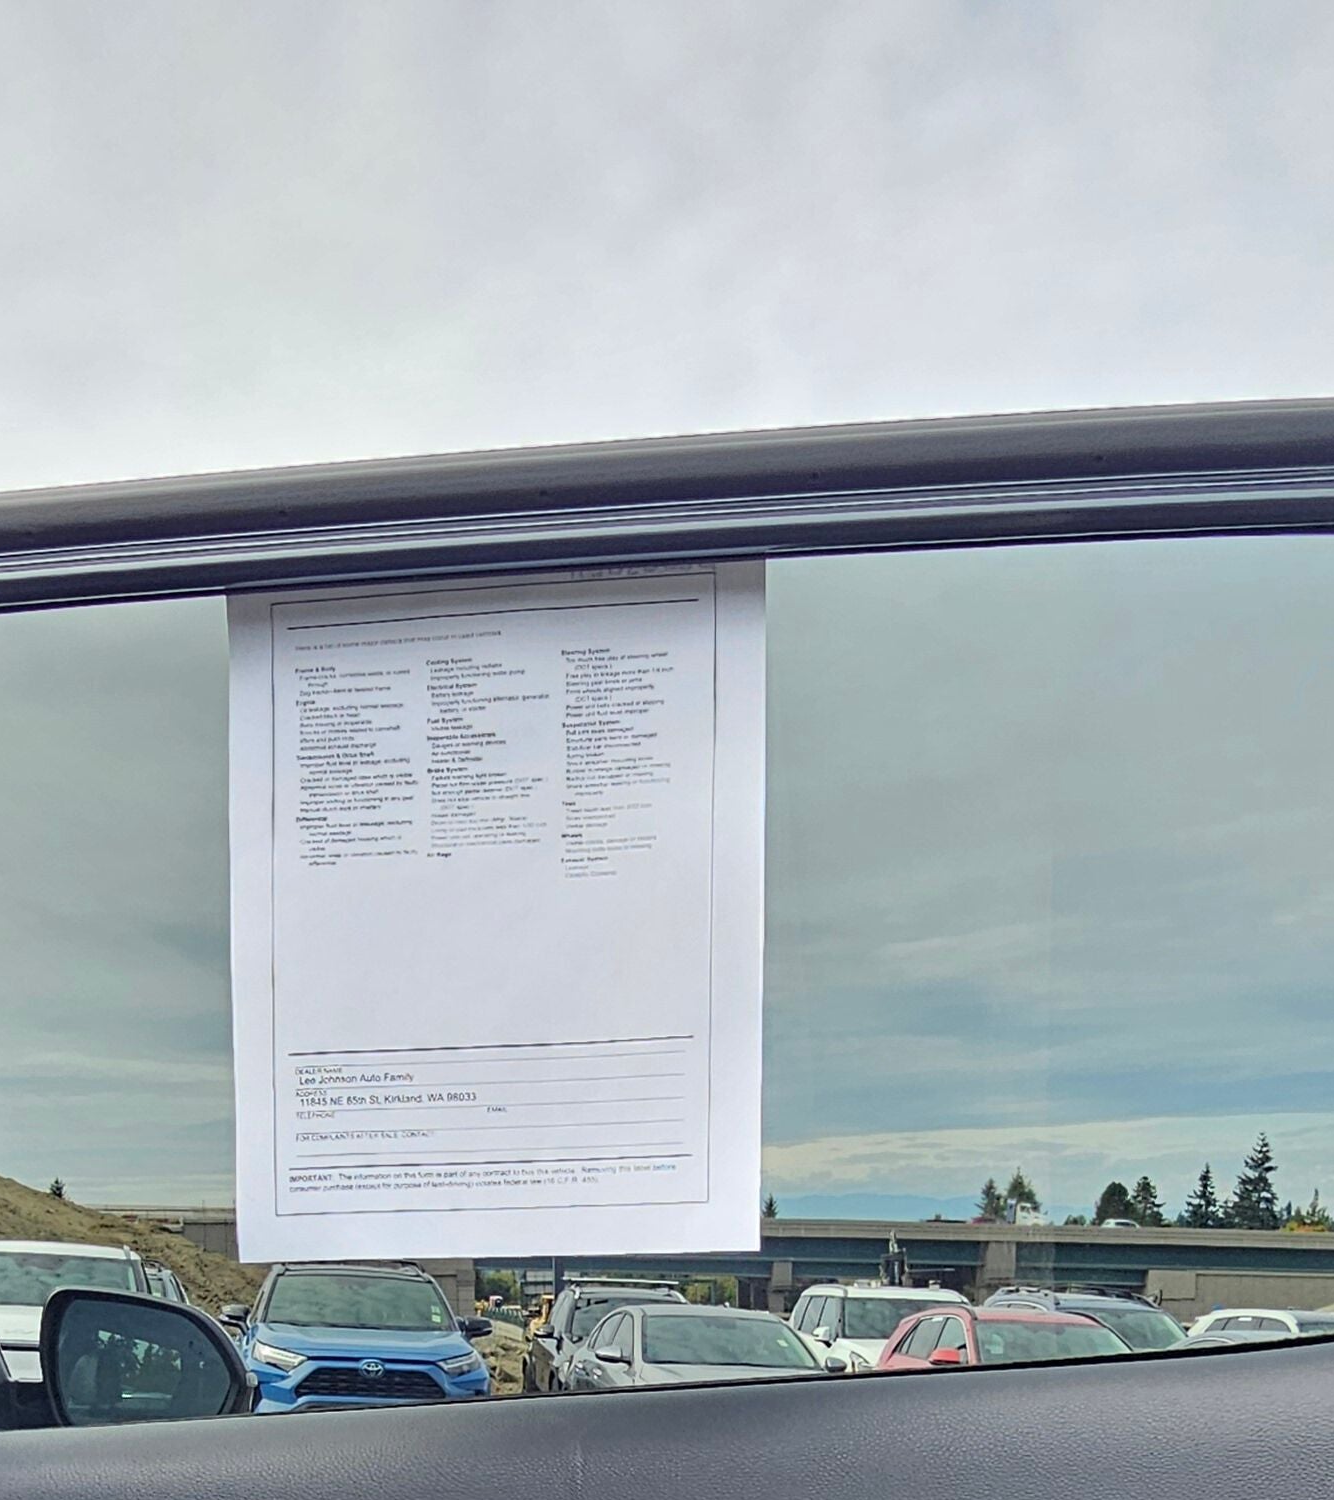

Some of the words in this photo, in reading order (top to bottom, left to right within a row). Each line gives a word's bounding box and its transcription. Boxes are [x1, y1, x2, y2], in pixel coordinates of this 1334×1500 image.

[299, 1076, 316, 1086] Lee
[319, 1075, 357, 1085] Johnson
[360, 1073, 381, 1083] Auto
[384, 1072, 414, 1082] Family
[330, 1096, 343, 1105] NE
[427, 1092, 444, 1101] WA
